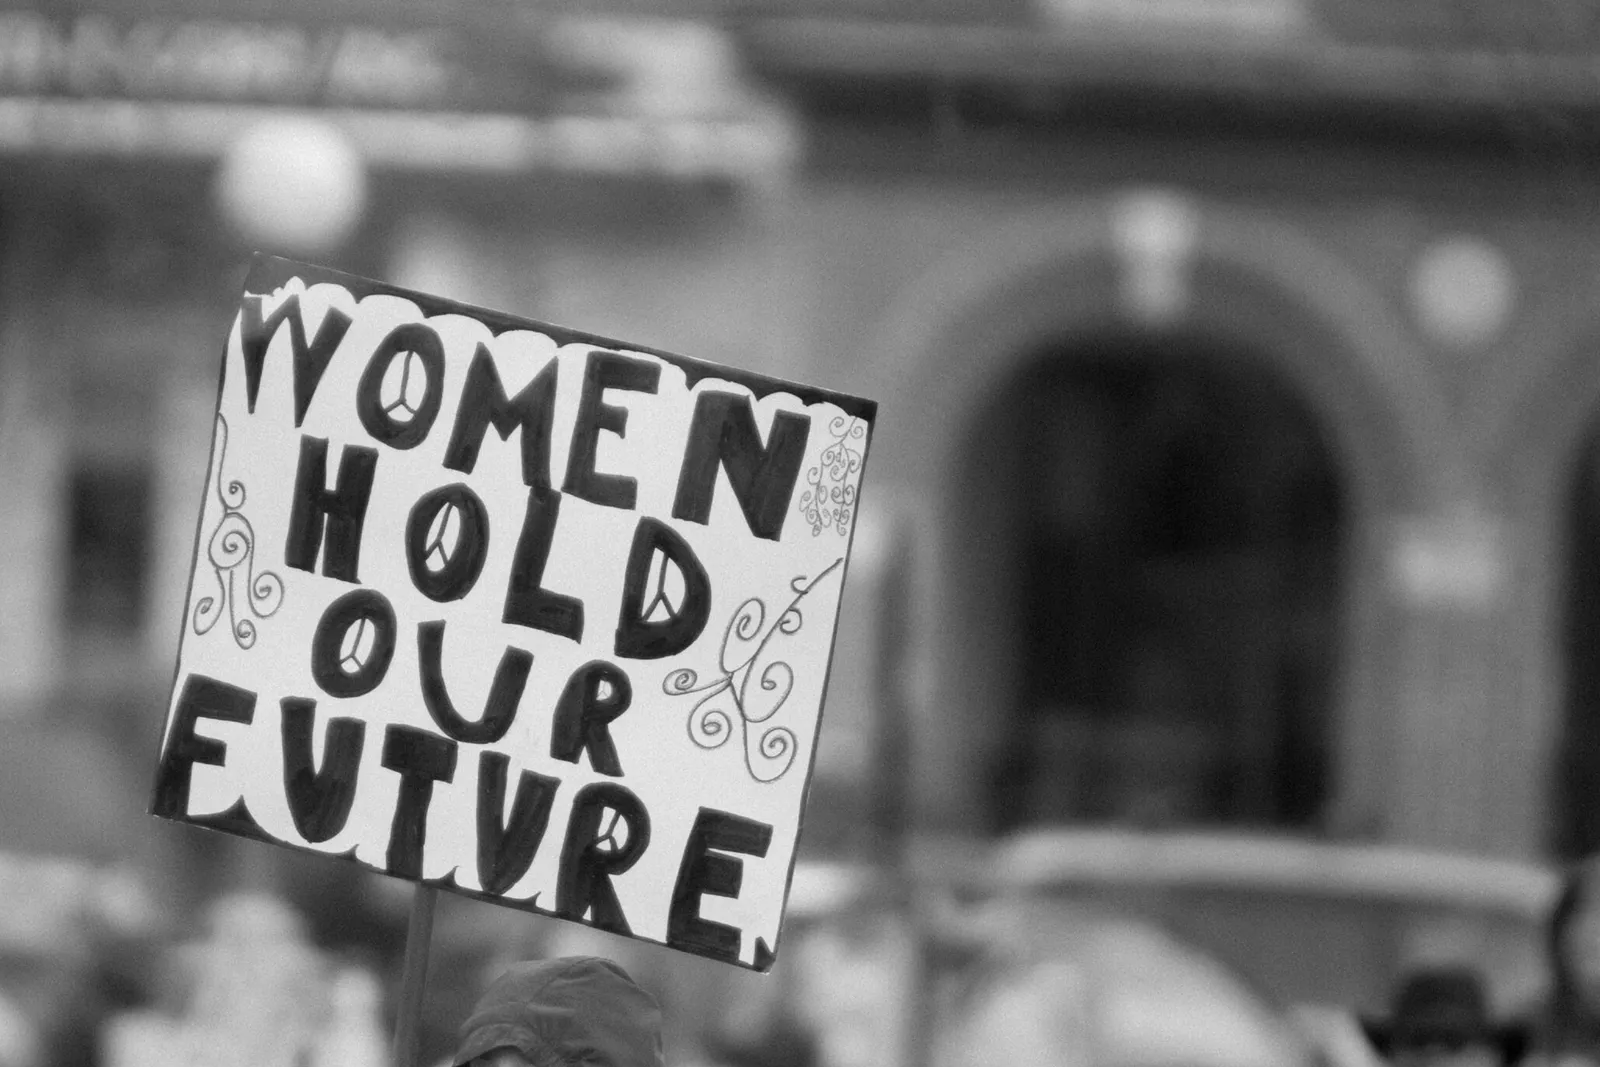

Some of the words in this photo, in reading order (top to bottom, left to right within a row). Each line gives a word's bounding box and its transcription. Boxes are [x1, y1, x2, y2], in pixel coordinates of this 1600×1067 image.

[240, 296, 812, 542] WOMEN
[284, 434, 712, 661] HOLD
[310, 587, 633, 777] OUR
[152, 672, 774, 957] FUTURE
